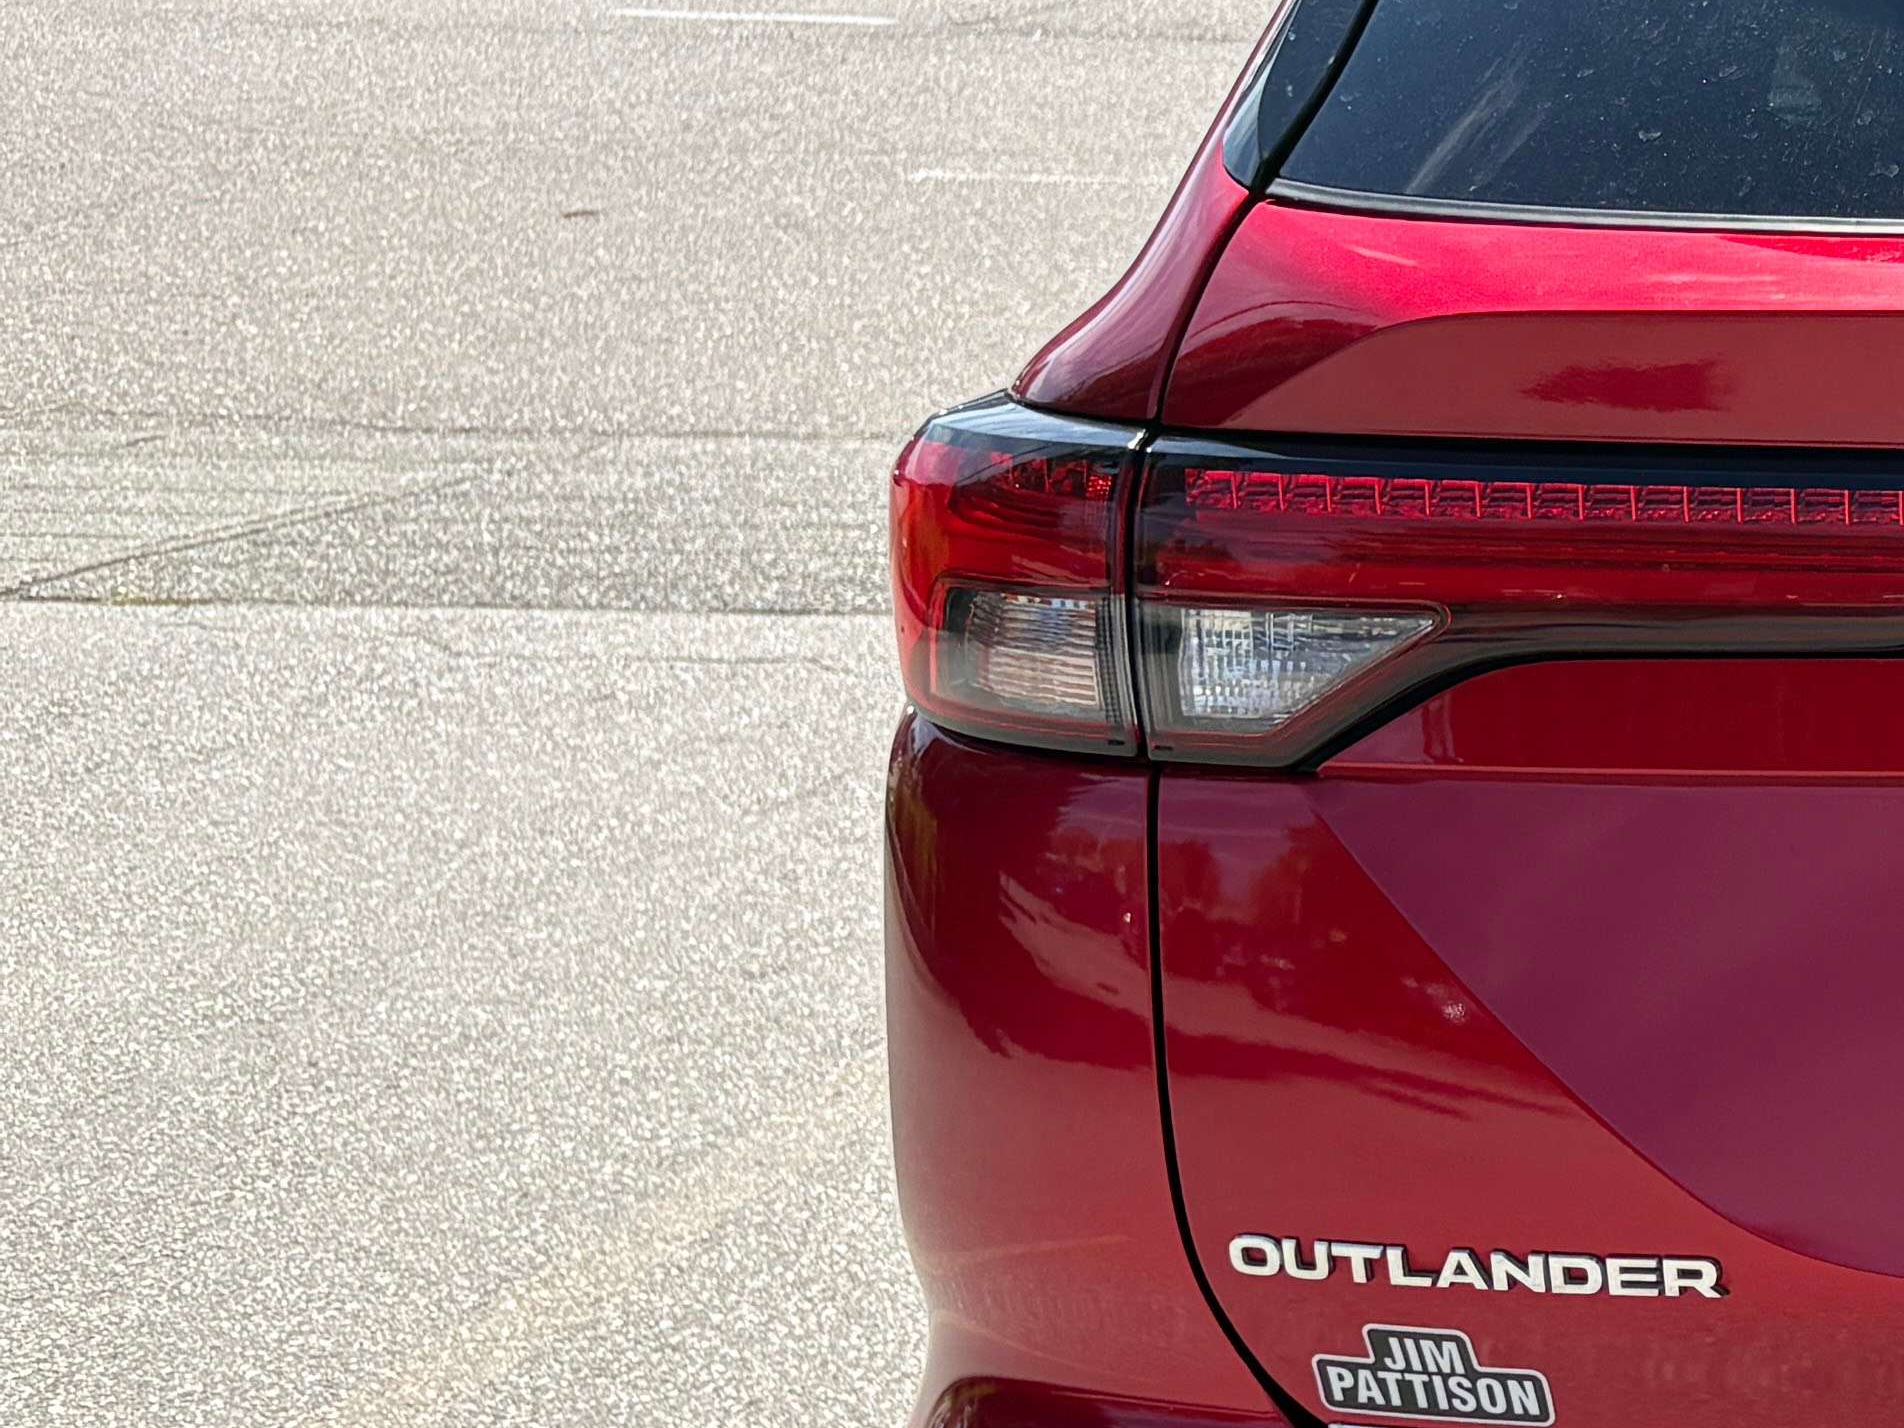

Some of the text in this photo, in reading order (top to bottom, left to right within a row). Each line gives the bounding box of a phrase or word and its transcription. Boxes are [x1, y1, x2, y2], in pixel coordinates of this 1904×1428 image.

[1228, 1233, 1729, 1299] OUTLANDER
[1384, 1336, 1467, 1375] JIM
[1325, 1364, 1541, 1417] PATTISON
